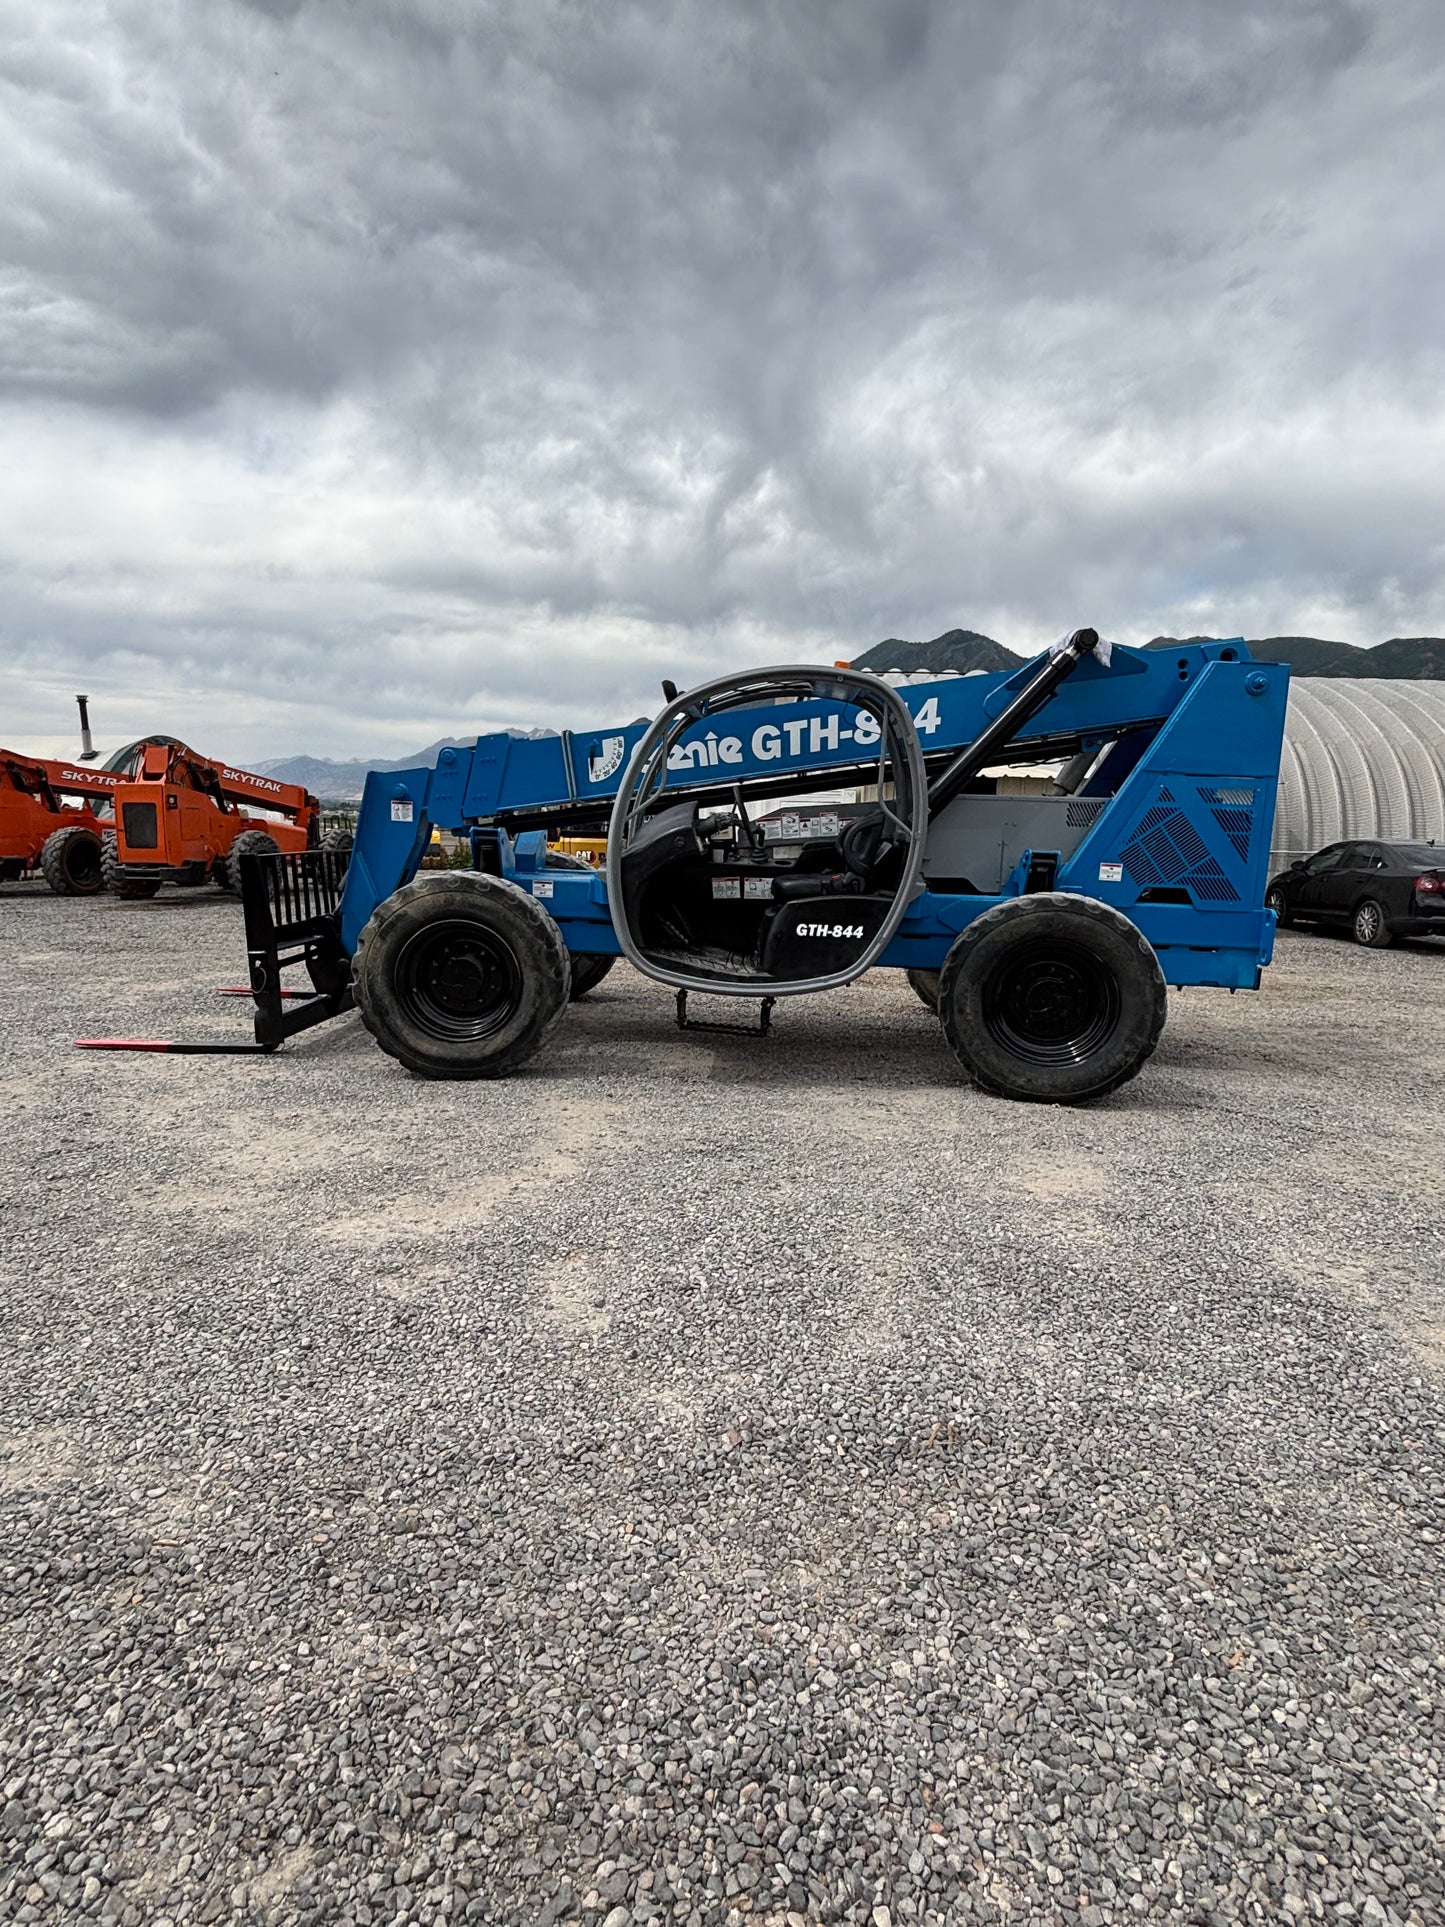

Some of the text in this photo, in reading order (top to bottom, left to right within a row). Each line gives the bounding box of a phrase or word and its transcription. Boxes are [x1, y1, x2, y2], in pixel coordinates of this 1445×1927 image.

[752, 698, 942, 761] GTH-84
[222, 769, 281, 793] SKYTRAK
[576, 850, 592, 861] CAT
[796, 923, 864, 938] GTH-844
